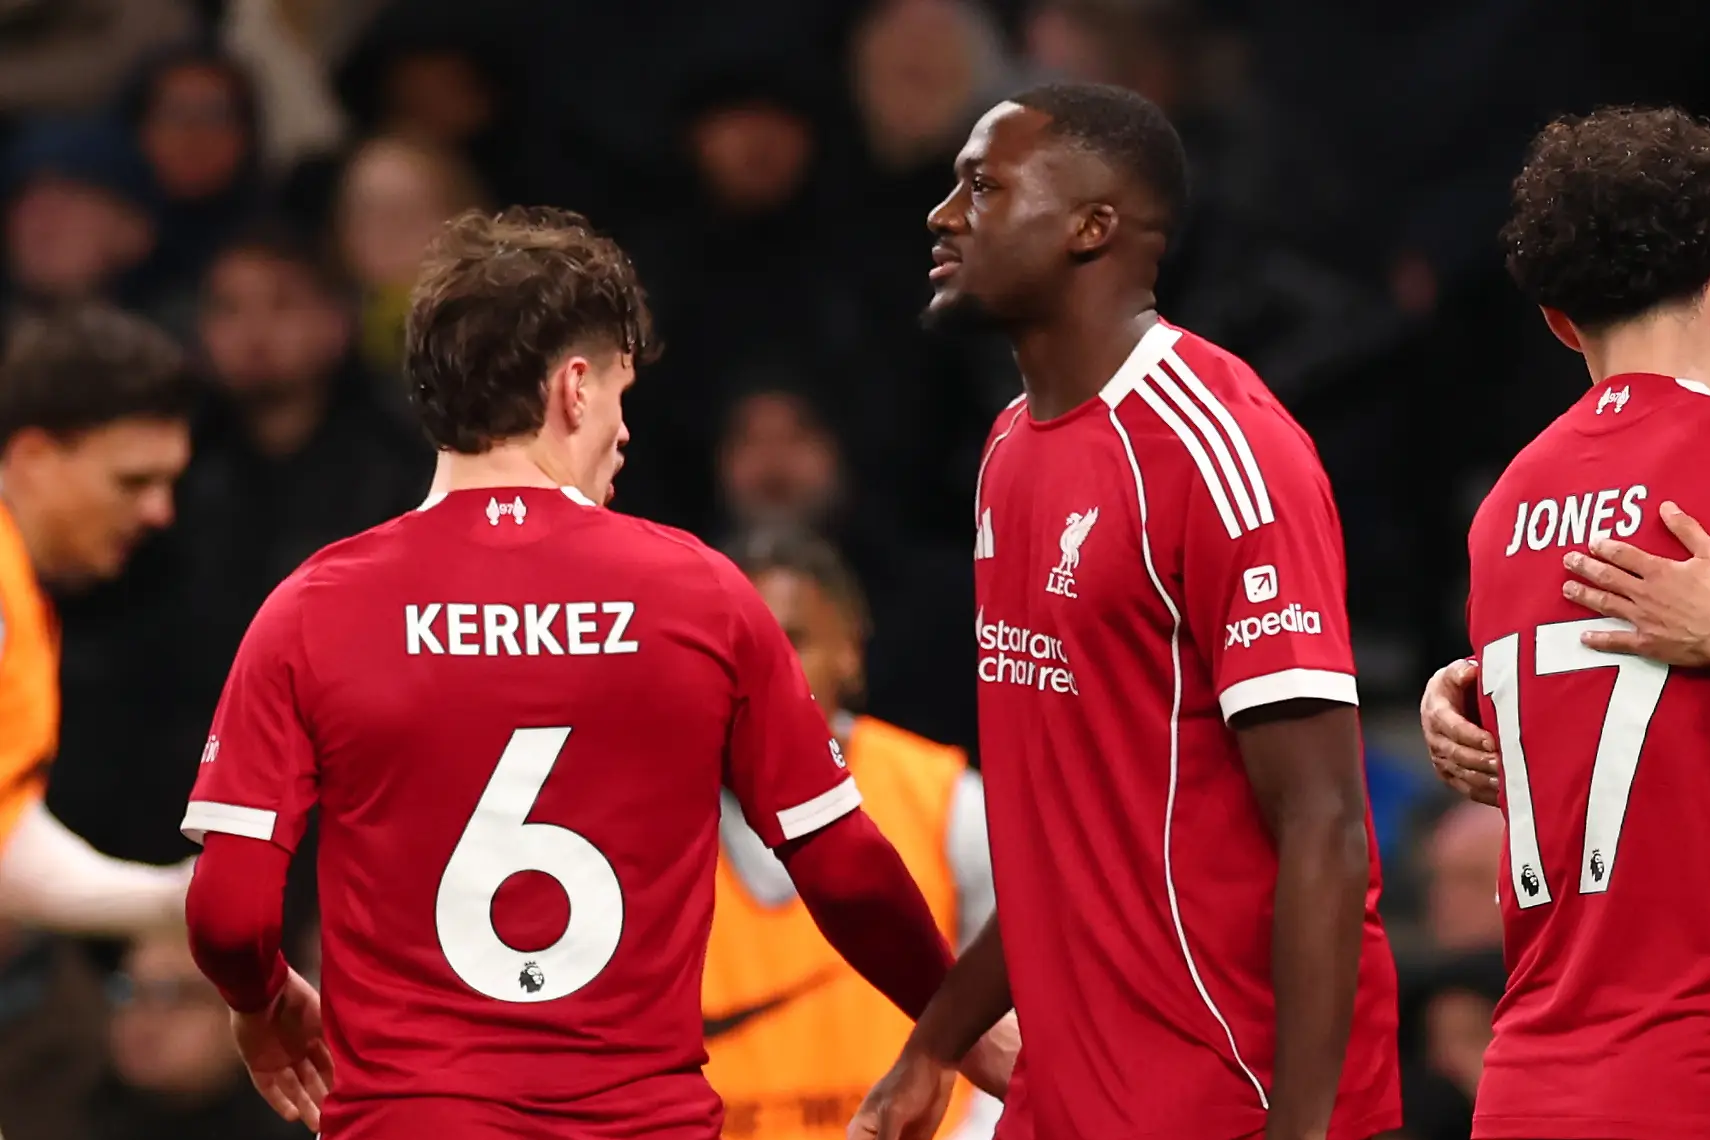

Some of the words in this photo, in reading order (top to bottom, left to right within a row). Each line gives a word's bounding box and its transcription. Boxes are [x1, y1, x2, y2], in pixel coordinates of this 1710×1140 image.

[1505, 484, 1648, 557] JONES
[404, 601, 640, 656] KERKEZ
[1224, 602, 1322, 651] xpedia
[1483, 616, 1670, 909] 17
[434, 726, 625, 1003] 6
